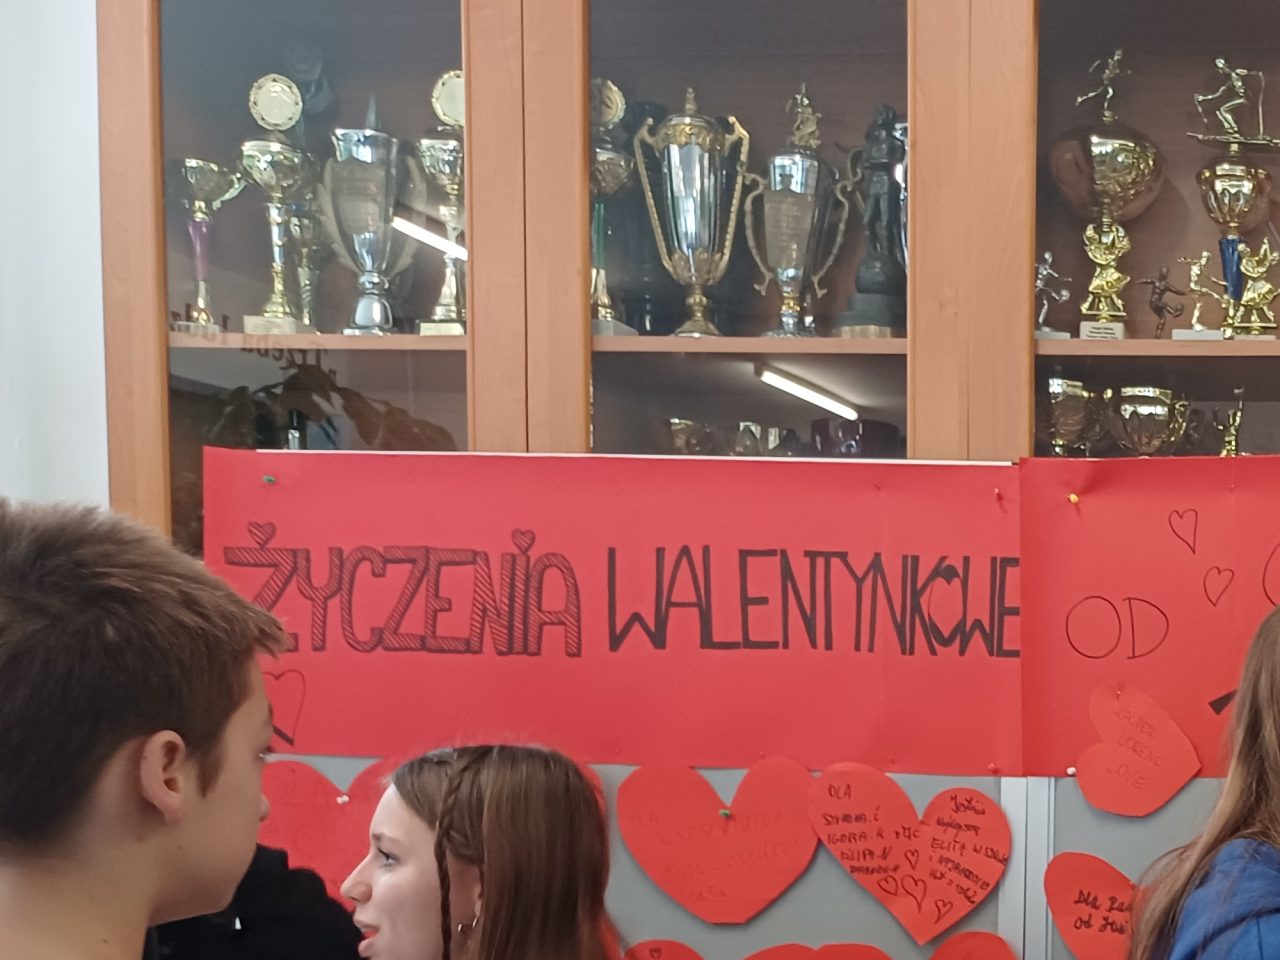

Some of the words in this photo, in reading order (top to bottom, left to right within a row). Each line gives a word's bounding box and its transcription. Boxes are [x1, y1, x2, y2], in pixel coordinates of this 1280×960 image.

[223, 521, 582, 658] ŻYCZENIA
[608, 544, 1021, 658] WALENTYNKOWE
[1065, 595, 1170, 660] OD
[828, 783, 852, 800] DLA
